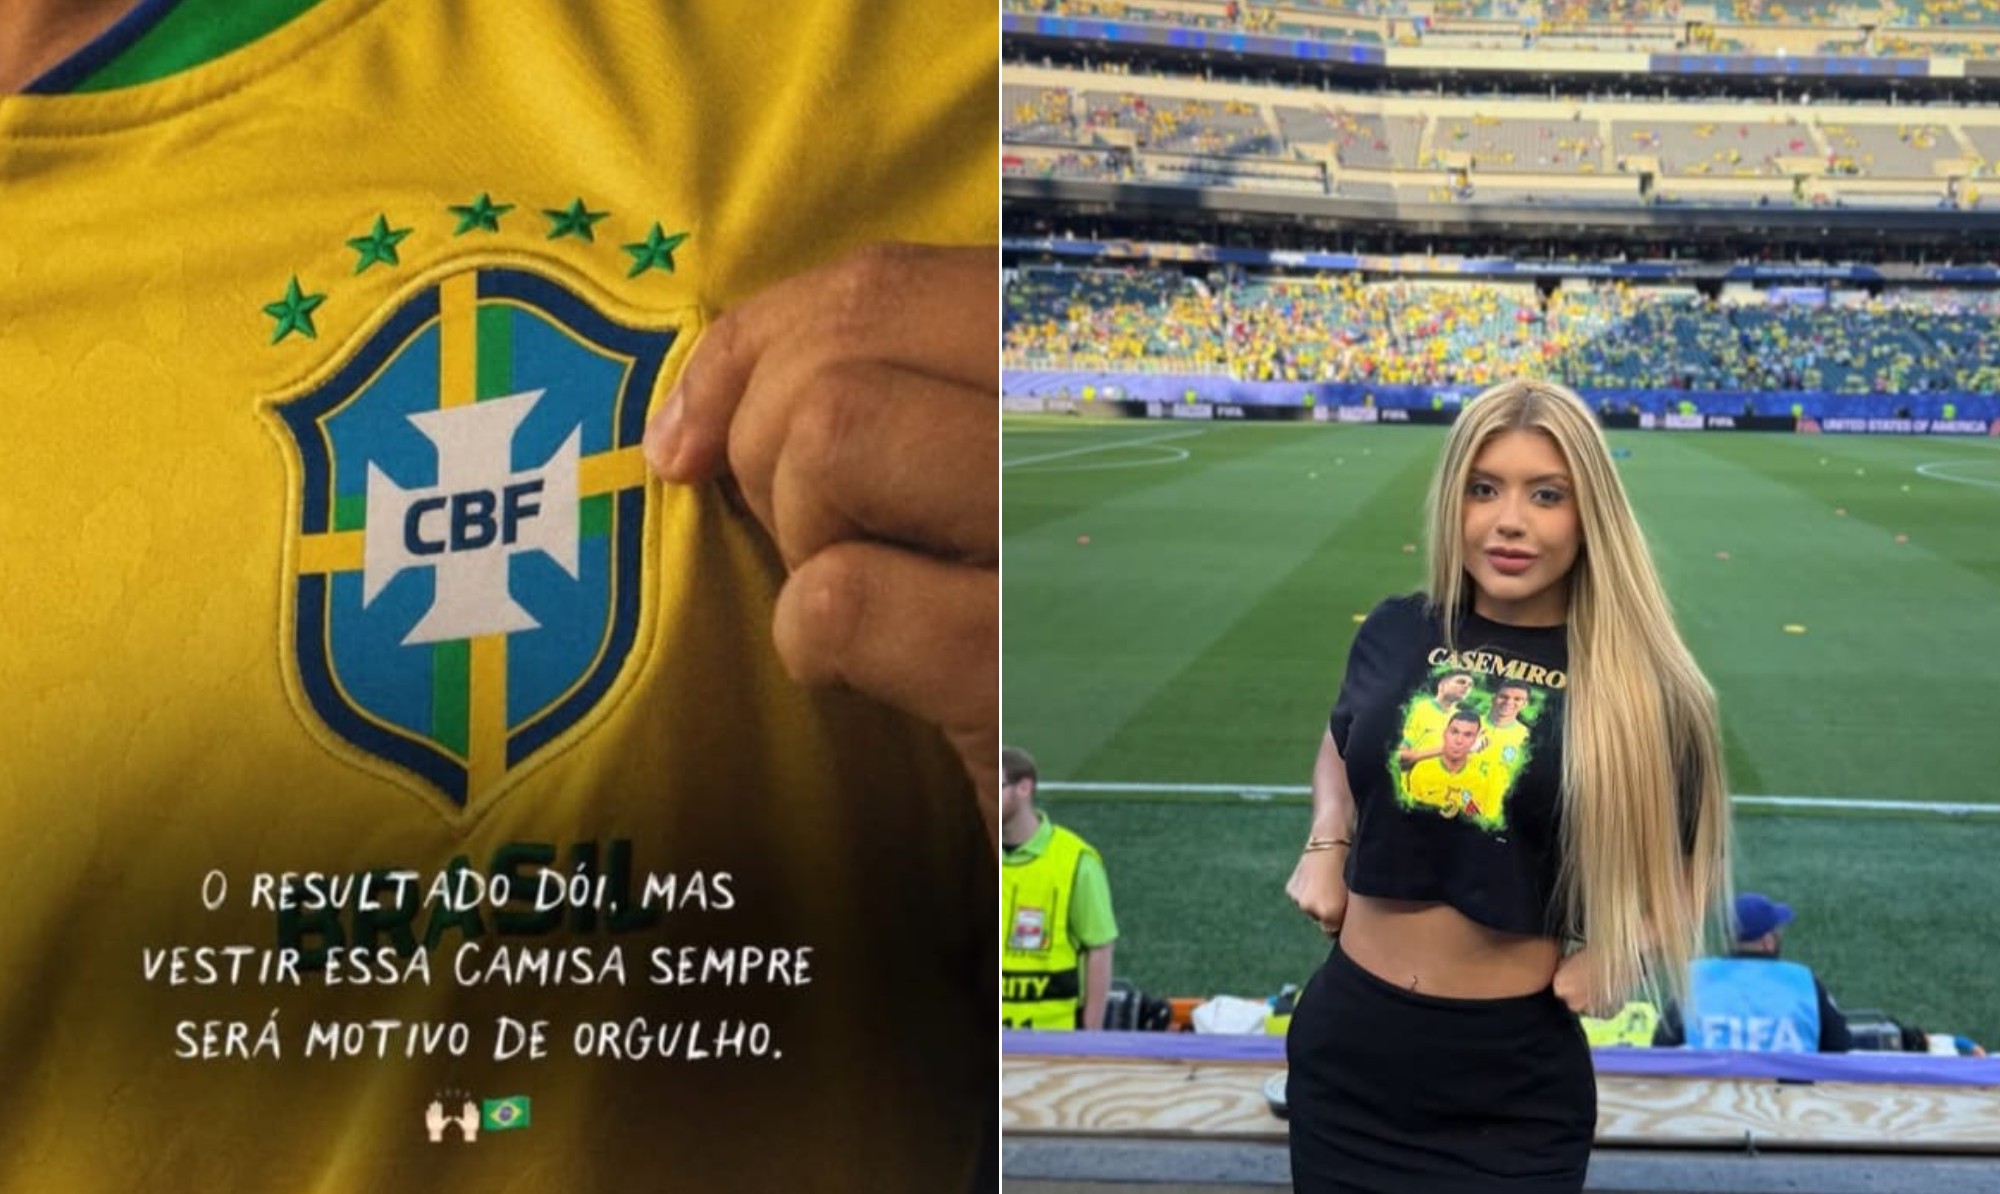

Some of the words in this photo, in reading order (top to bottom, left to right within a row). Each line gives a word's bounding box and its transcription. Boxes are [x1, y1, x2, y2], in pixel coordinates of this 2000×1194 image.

[1823, 418, 1867, 432] UNITED
[1868, 418, 1912, 432] STATES
[1913, 418, 1930, 432] OF
[1930, 419, 1988, 433] AMERICA
[404, 478, 545, 556] CBF
[1427, 647, 1568, 688] CASEMIRO
[276, 838, 662, 970] BRASIL
[1702, 1016, 1803, 1053] FIFA
